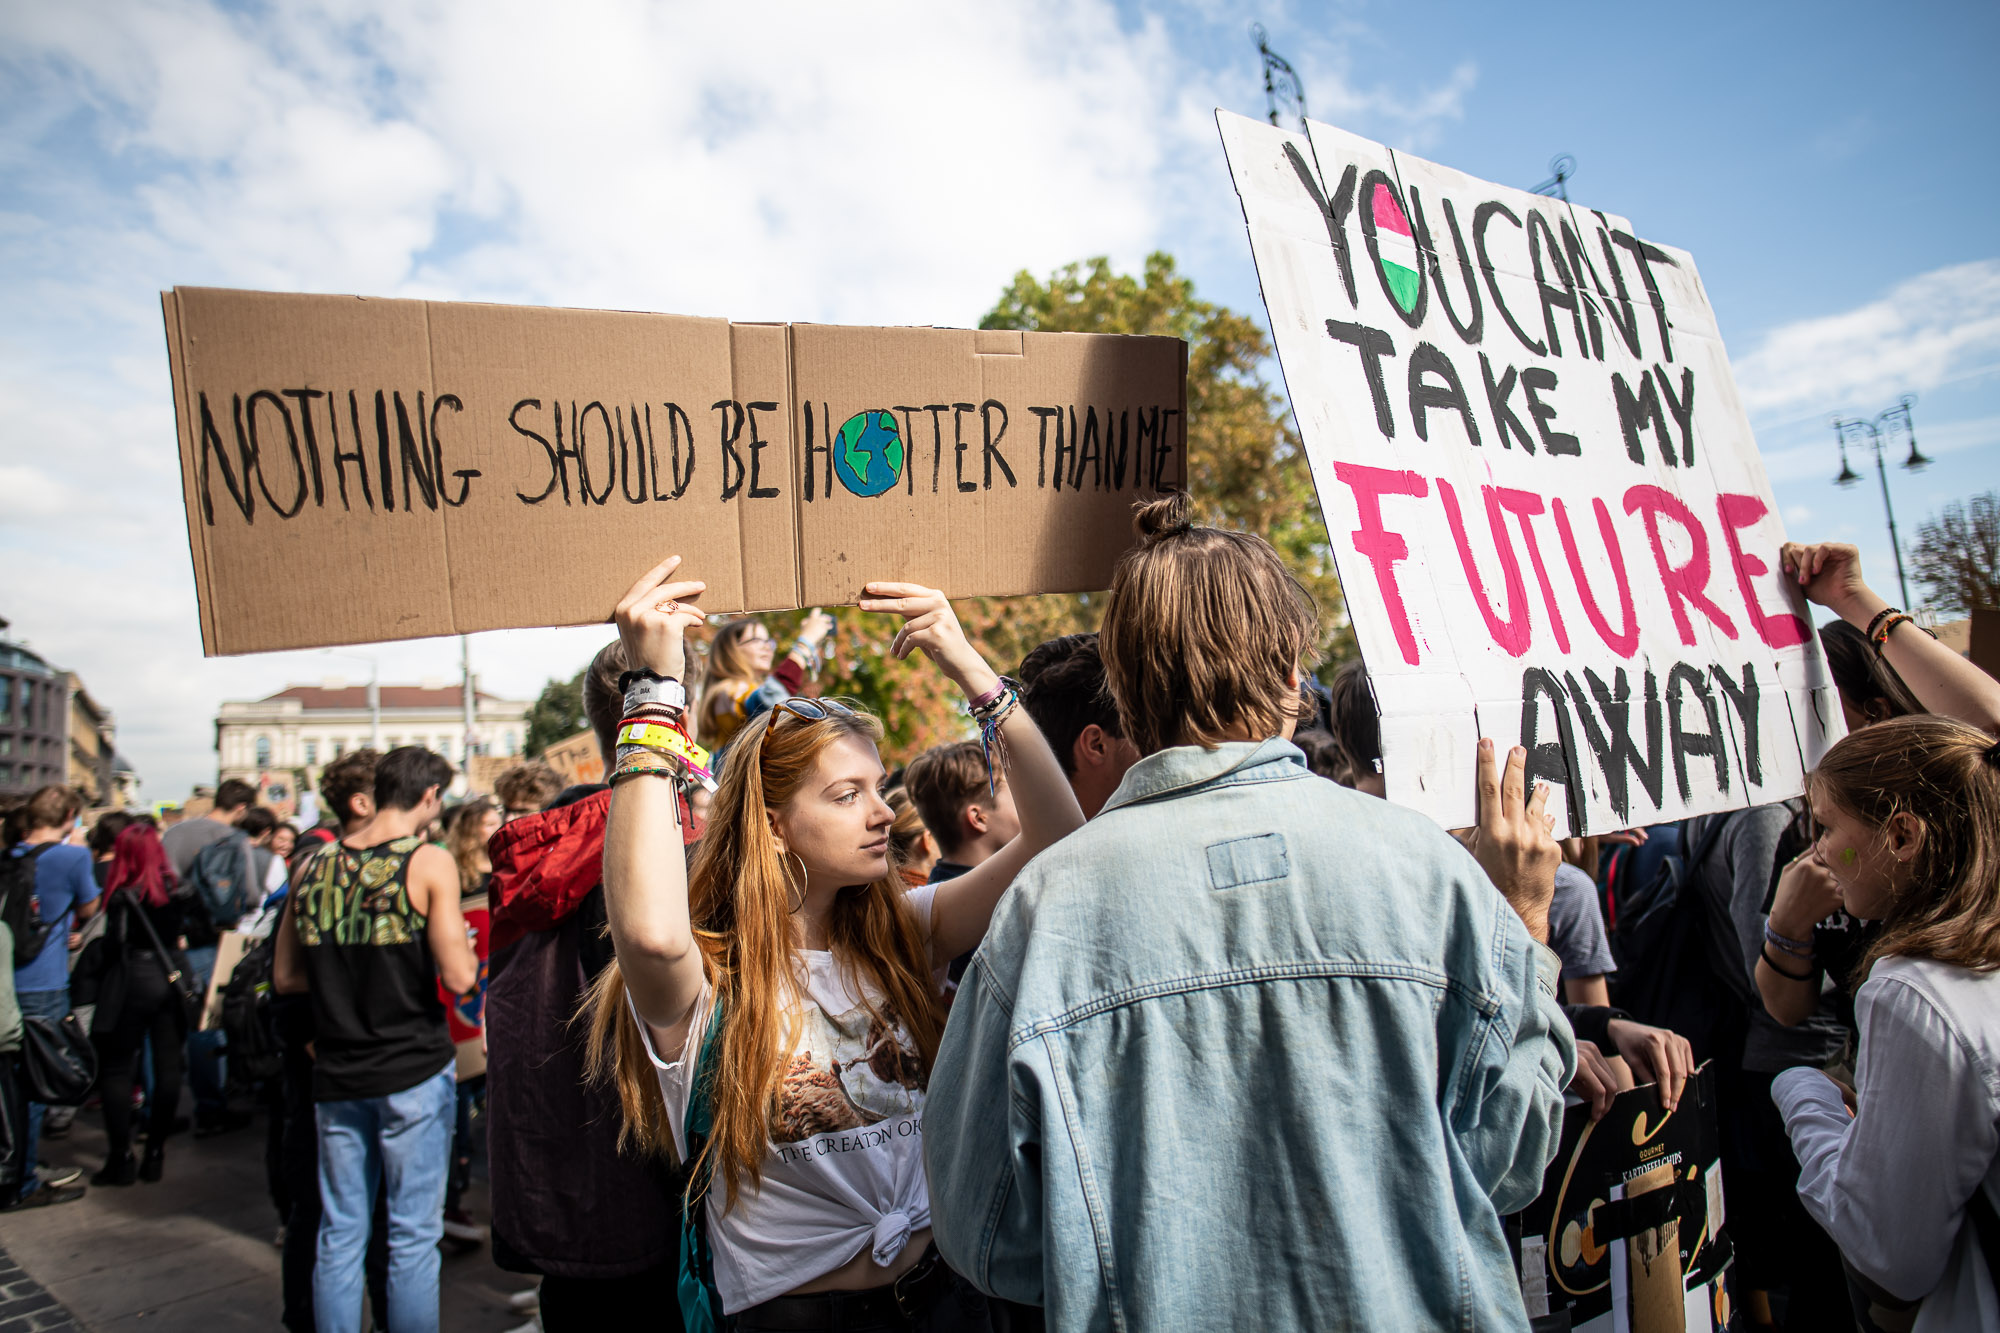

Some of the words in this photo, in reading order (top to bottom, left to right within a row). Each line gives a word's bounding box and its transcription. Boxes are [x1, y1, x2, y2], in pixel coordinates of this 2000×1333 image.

[199, 386, 482, 526] NOTHING
[508, 398, 696, 506] SHOULD
[712, 399, 780, 502] BE
[1327, 319, 1581, 457] TAKE
[1611, 363, 1694, 469] MY
[1334, 461, 1813, 666] FUTURE
[1519, 658, 1762, 838] AWAY
[776, 1146, 812, 1164] THE
[1639, 1143, 1665, 1159] GOURMET
